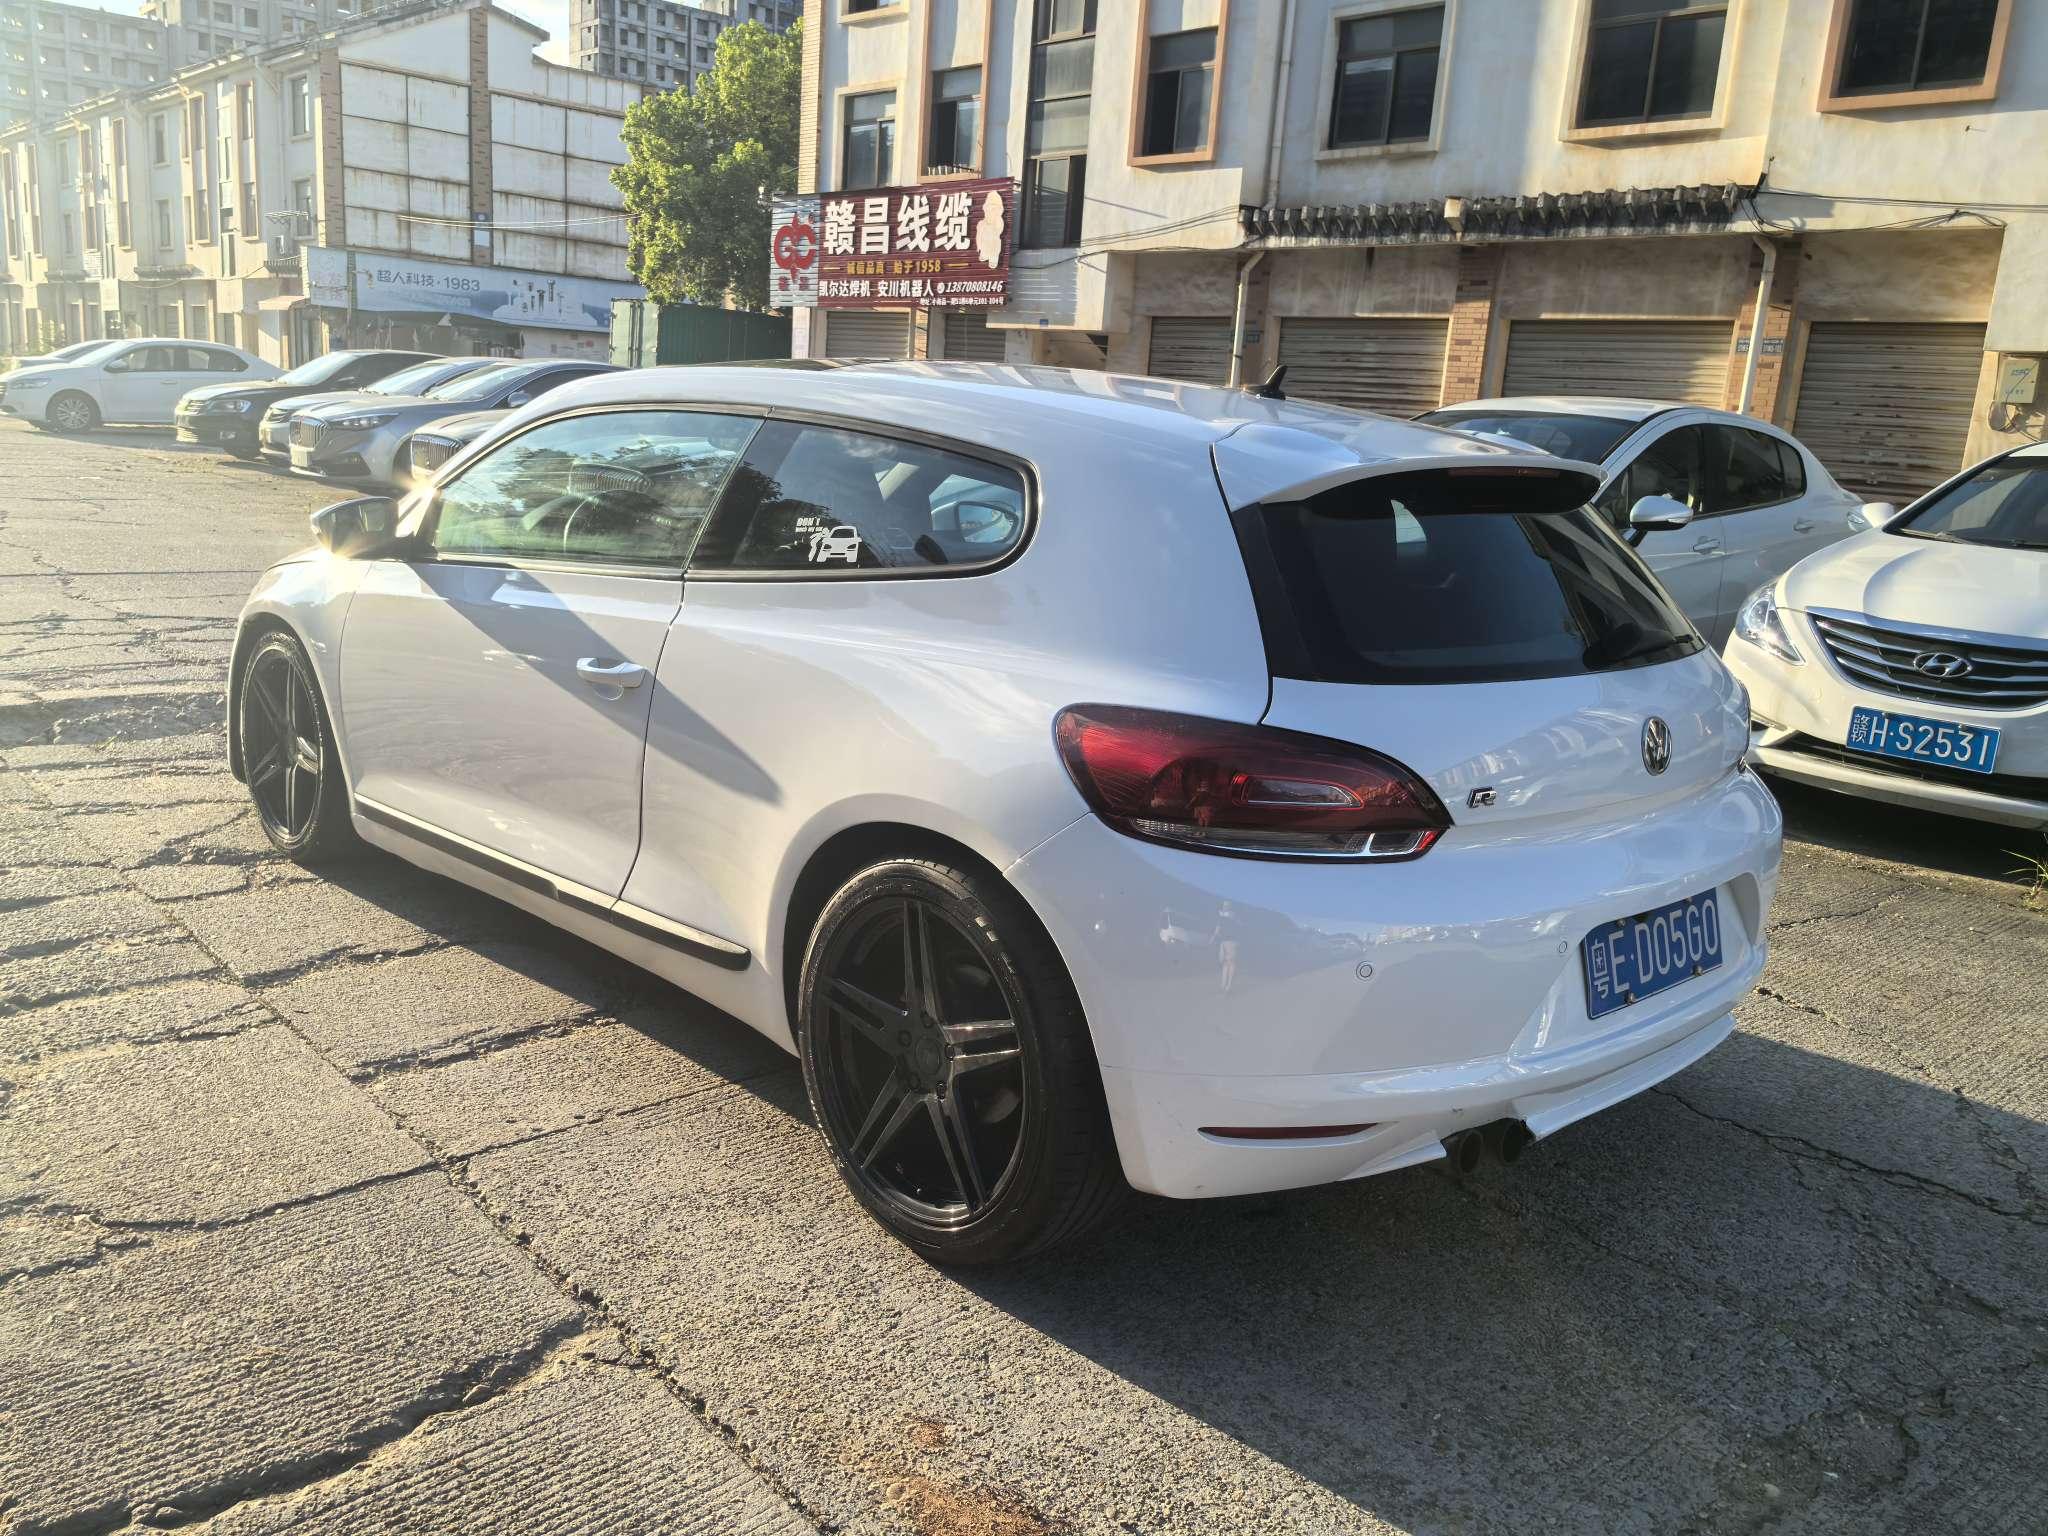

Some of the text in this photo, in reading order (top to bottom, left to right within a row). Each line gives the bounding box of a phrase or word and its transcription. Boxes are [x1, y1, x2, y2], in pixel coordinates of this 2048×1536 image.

[823, 192, 973, 255] 赣昌线缆
[818, 280, 870, 298] 凯尔达焊机
[878, 279, 934, 297] 安川机器人
